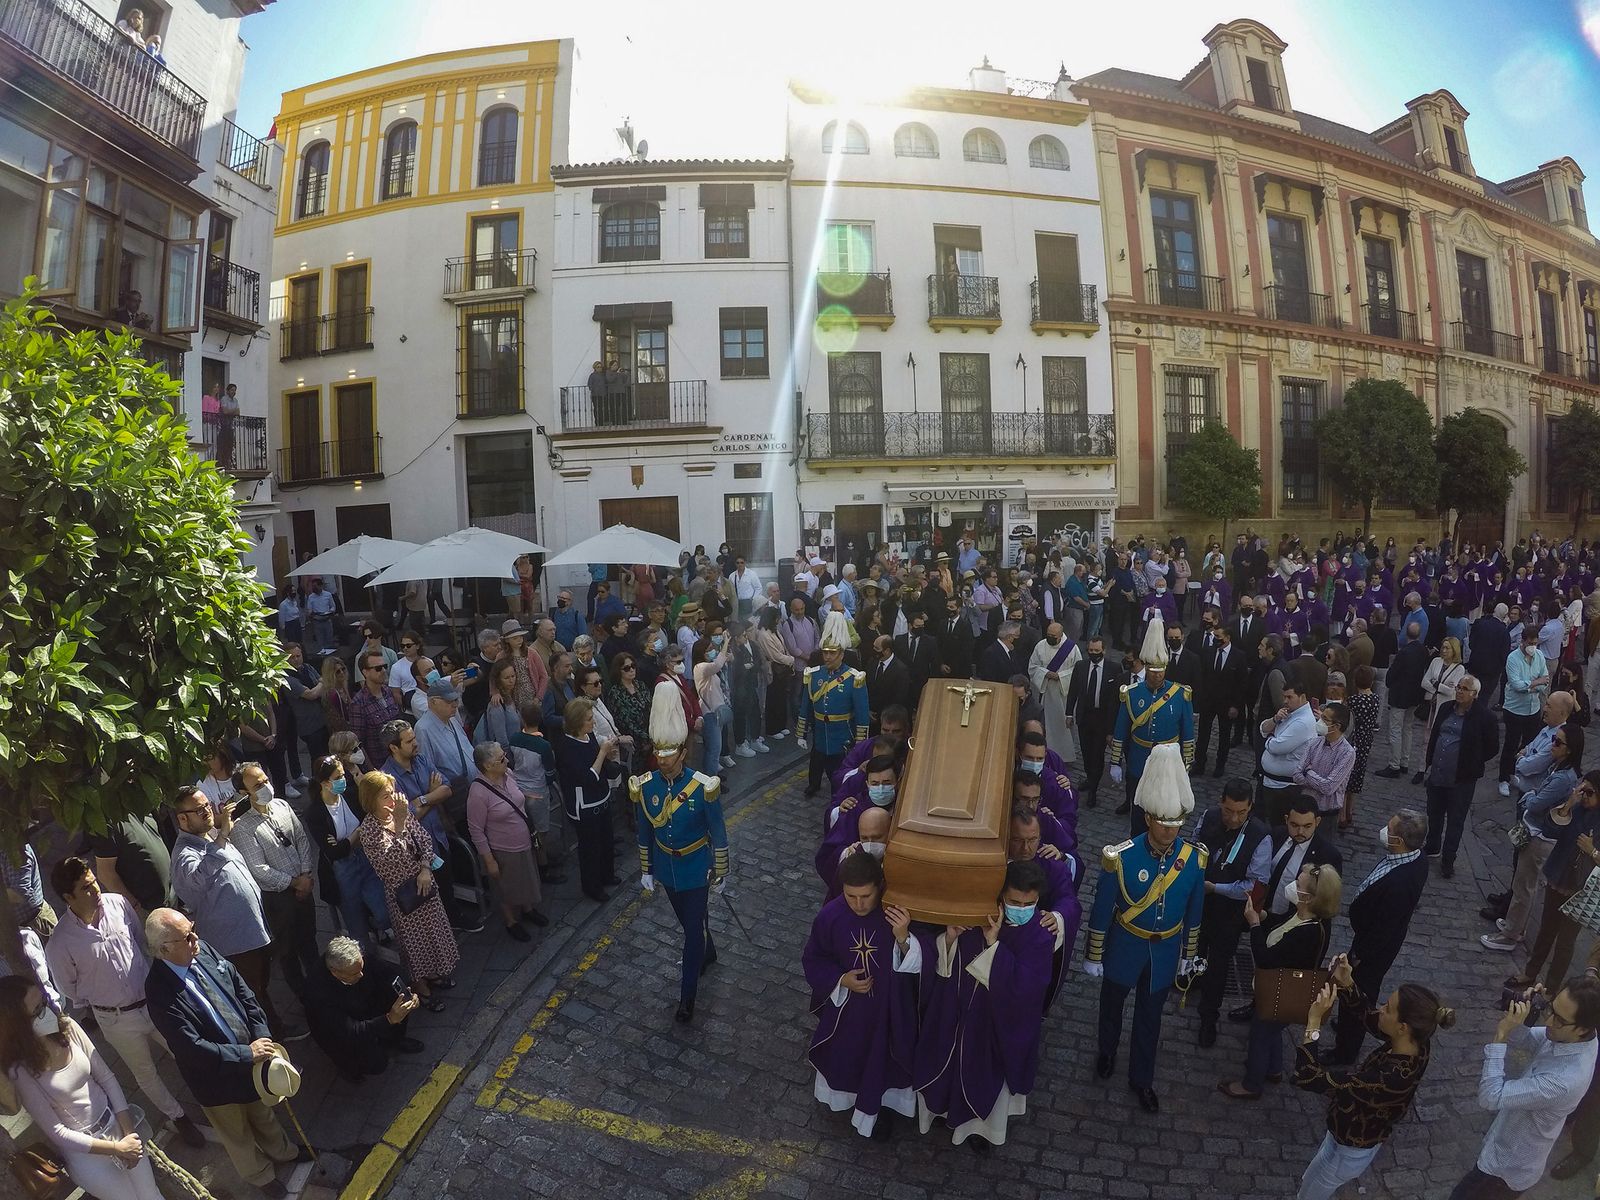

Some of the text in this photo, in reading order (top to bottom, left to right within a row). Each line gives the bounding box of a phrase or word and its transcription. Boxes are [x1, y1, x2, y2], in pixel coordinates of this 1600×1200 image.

[723, 433, 775, 441] CARDENAL
[712, 444, 750, 452] CARLOS
[909, 489, 1008, 501] SOUVENIRS
[1052, 500, 1071, 508] TAKE
